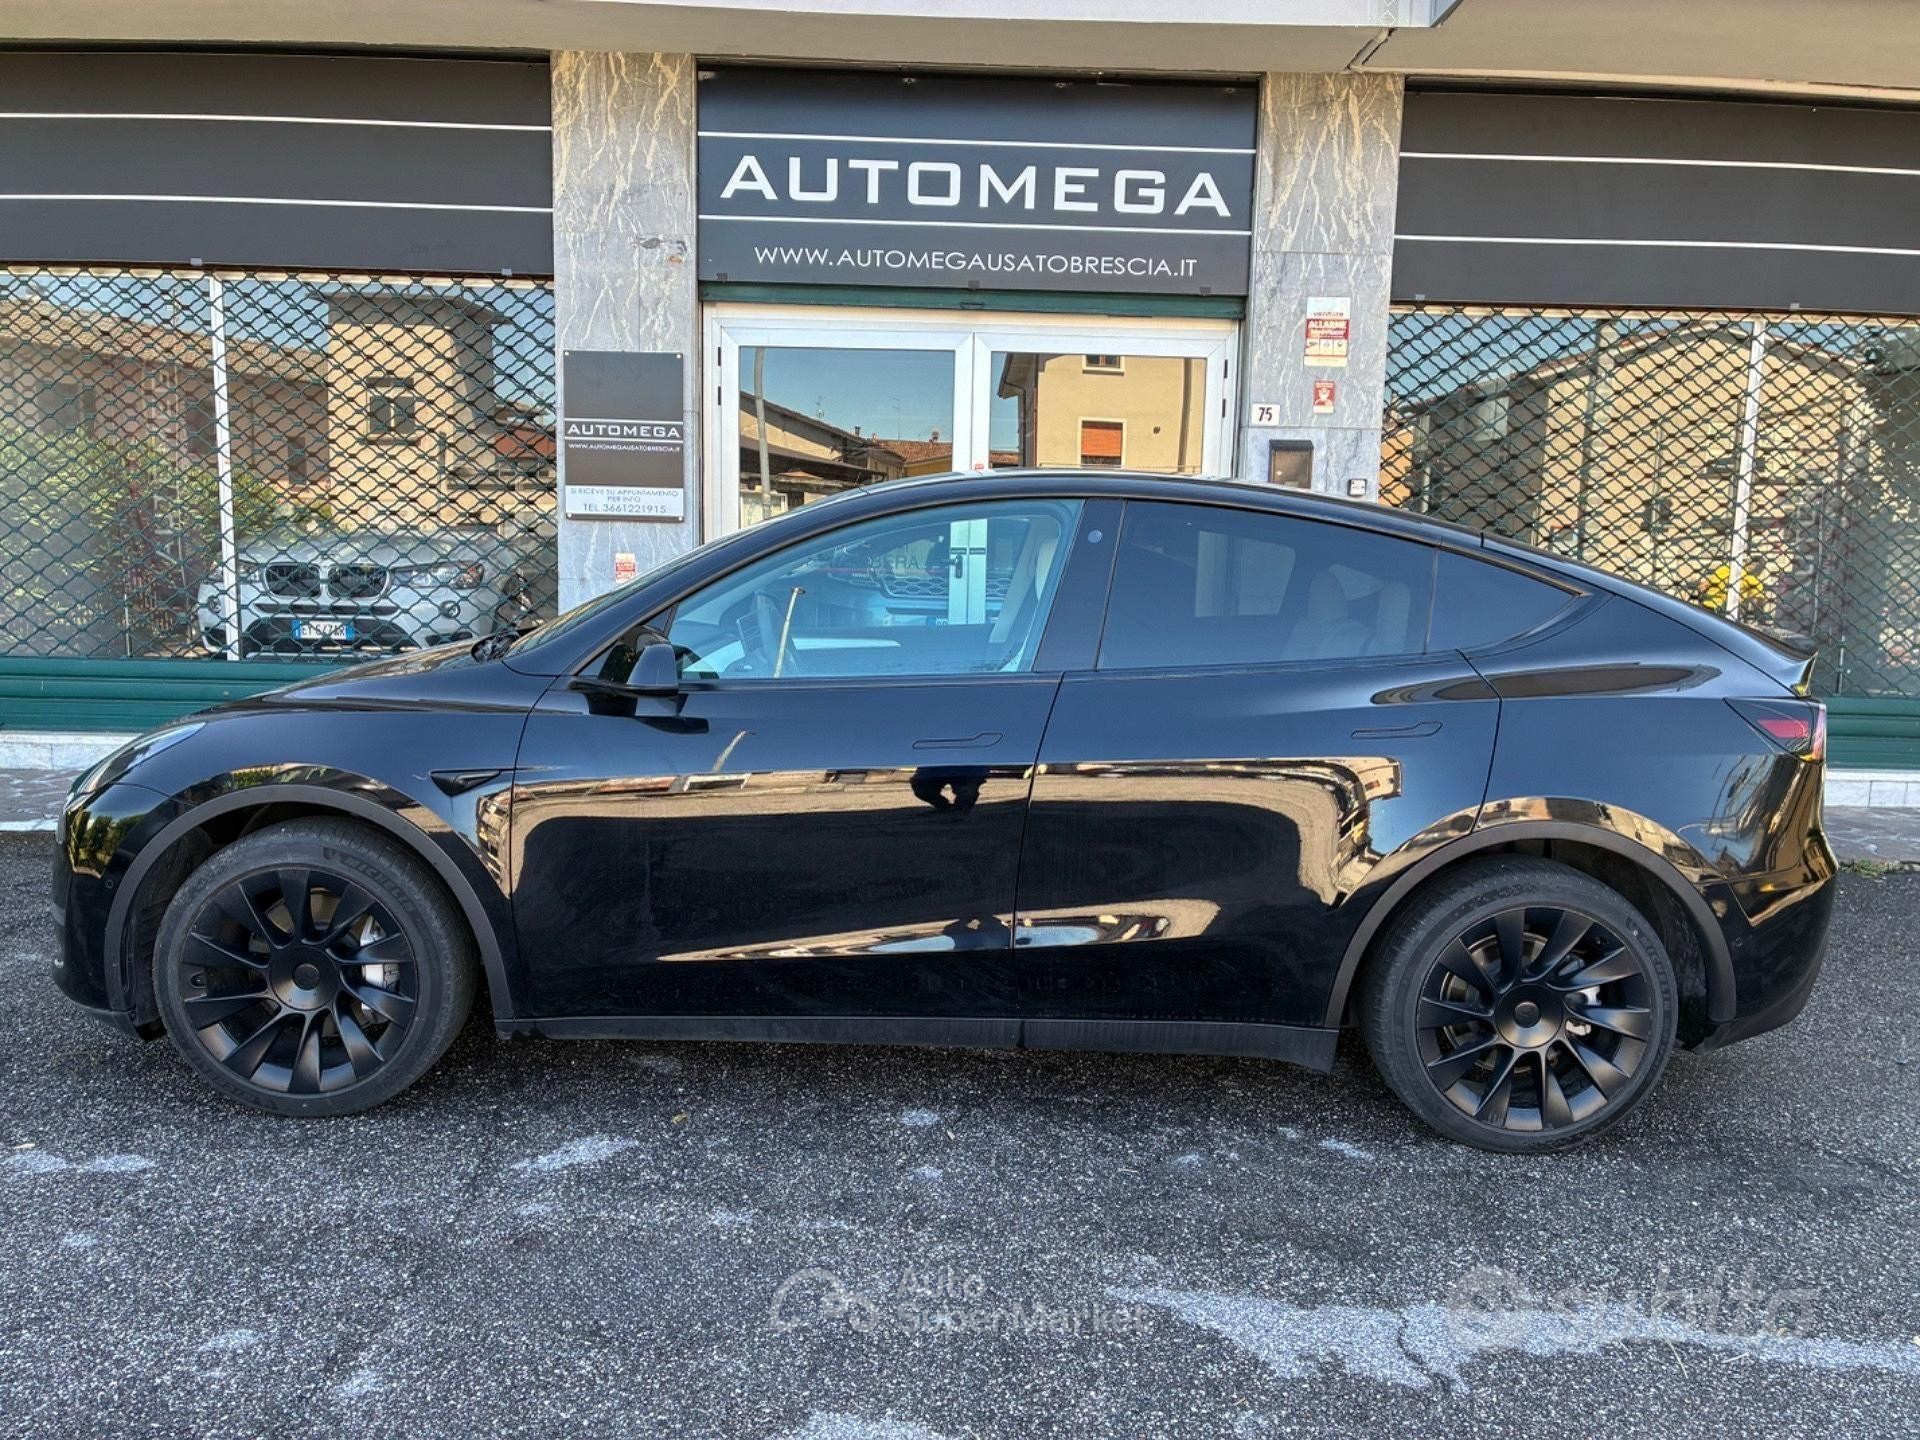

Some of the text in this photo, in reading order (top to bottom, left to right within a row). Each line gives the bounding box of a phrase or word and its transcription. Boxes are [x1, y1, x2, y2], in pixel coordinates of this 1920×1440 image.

[719, 154, 1232, 217] AUTOMEGA
[754, 246, 1198, 278] WWW.AUTOMEGAUSATOBRESCIA.IT
[1258, 406, 1273, 422] 75
[567, 424, 681, 438] AUTOMEGA
[578, 487, 605, 496] RICEVE
[606, 488, 615, 496] SU
[617, 489, 679, 497] APPUNTAMENTO
[603, 503, 667, 514] 3661221915
